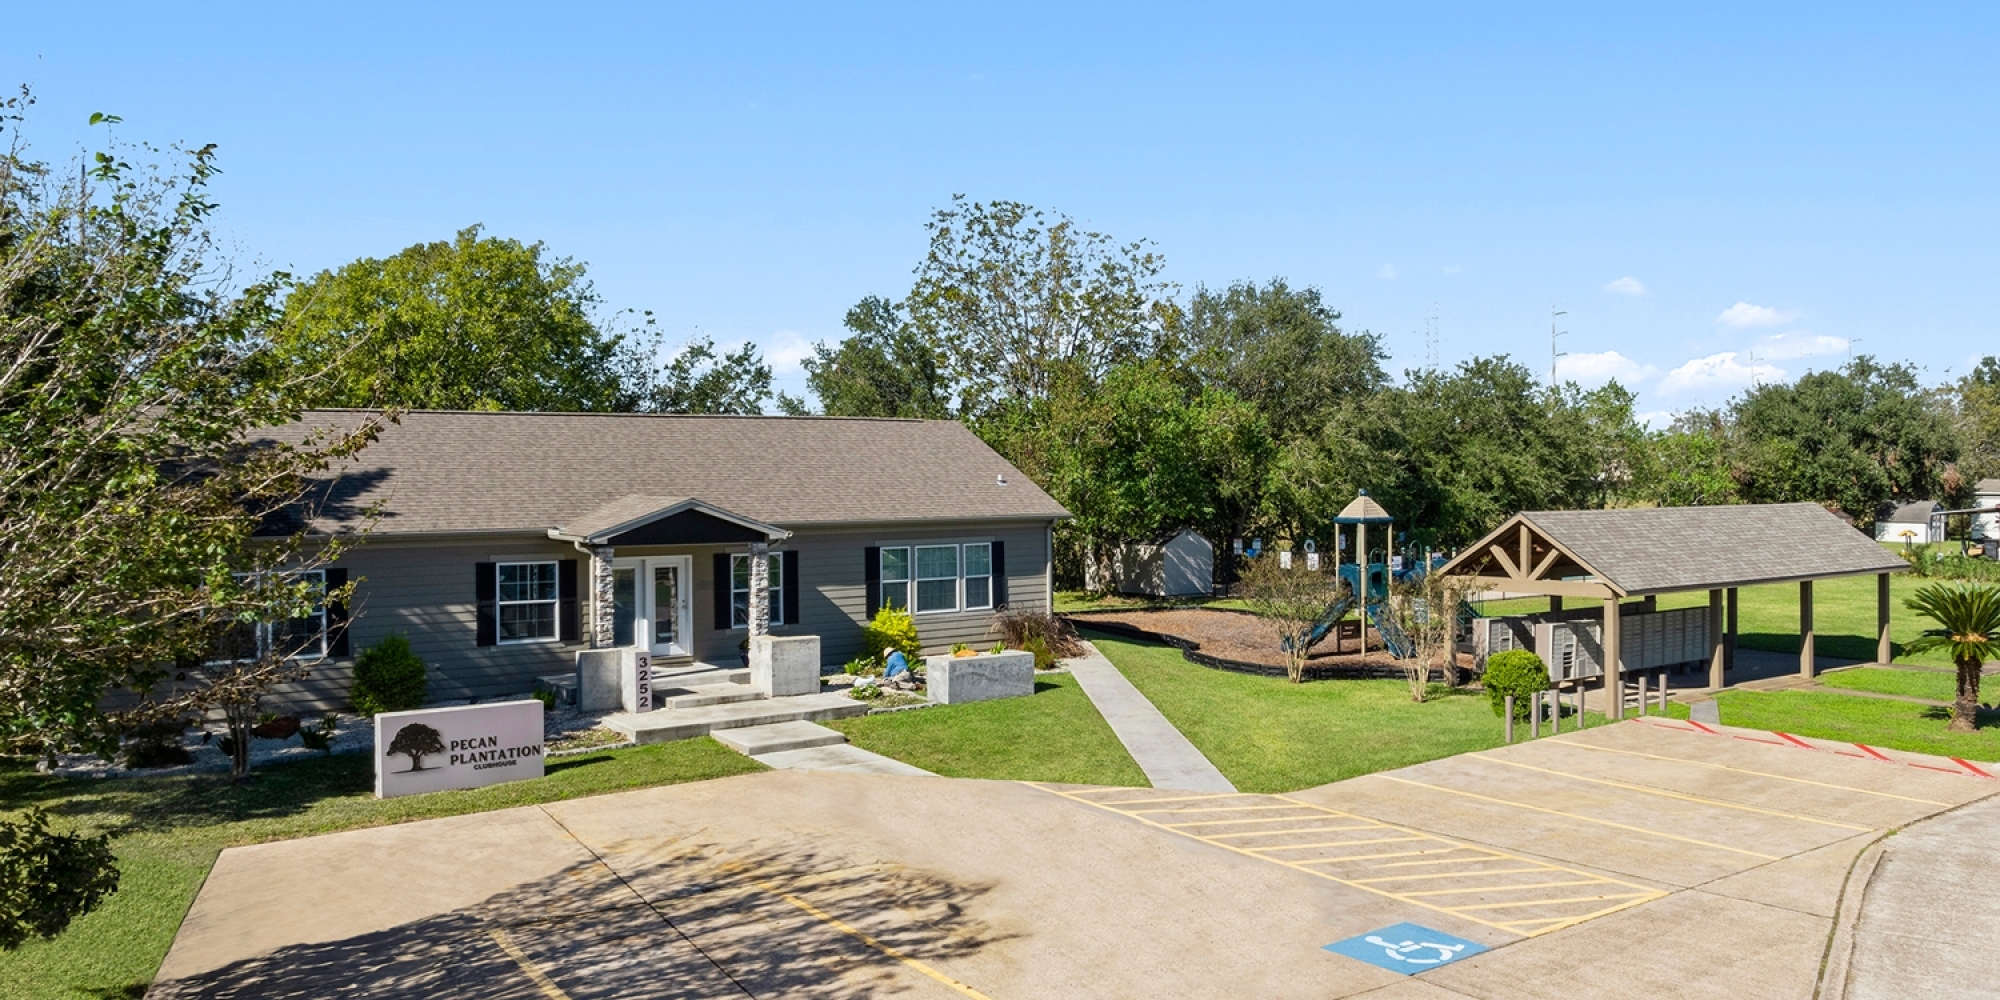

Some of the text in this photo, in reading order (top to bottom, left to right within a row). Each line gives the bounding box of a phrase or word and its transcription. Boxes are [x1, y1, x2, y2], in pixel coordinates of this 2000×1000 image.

[639, 656, 649, 708] 3252
[450, 736, 497, 751] PECAN
[450, 744, 541, 765] PLANTATION
[473, 760, 517, 770] CLUBHOUSE
